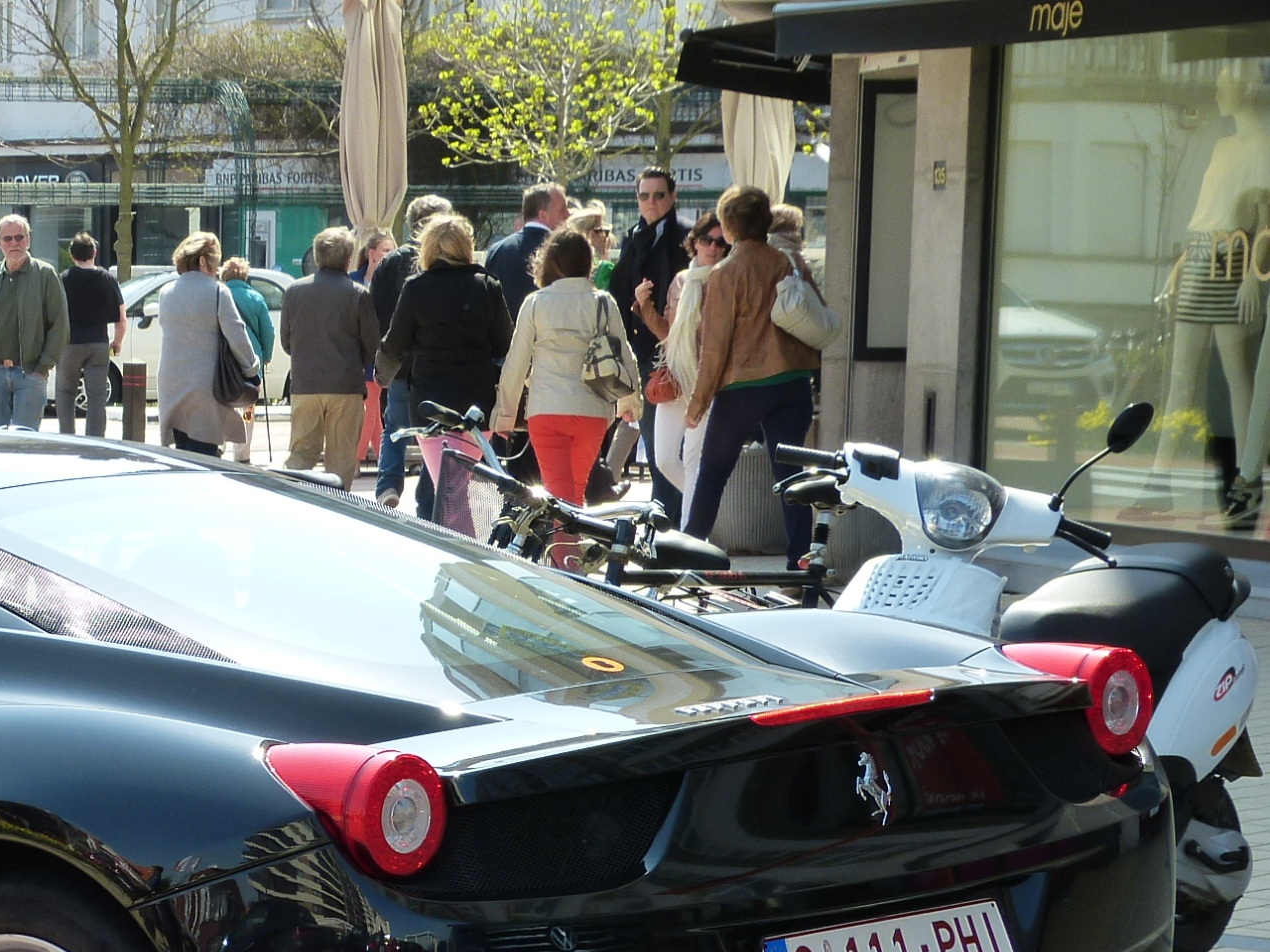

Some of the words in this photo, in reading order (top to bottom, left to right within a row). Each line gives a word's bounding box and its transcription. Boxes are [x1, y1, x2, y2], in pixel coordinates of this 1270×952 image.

[1029, 0, 1083, 36] maje
[215, 172, 236, 185] BNP
[287, 171, 324, 184] FORTIS
[1215, 674, 1233, 699] ZIP
